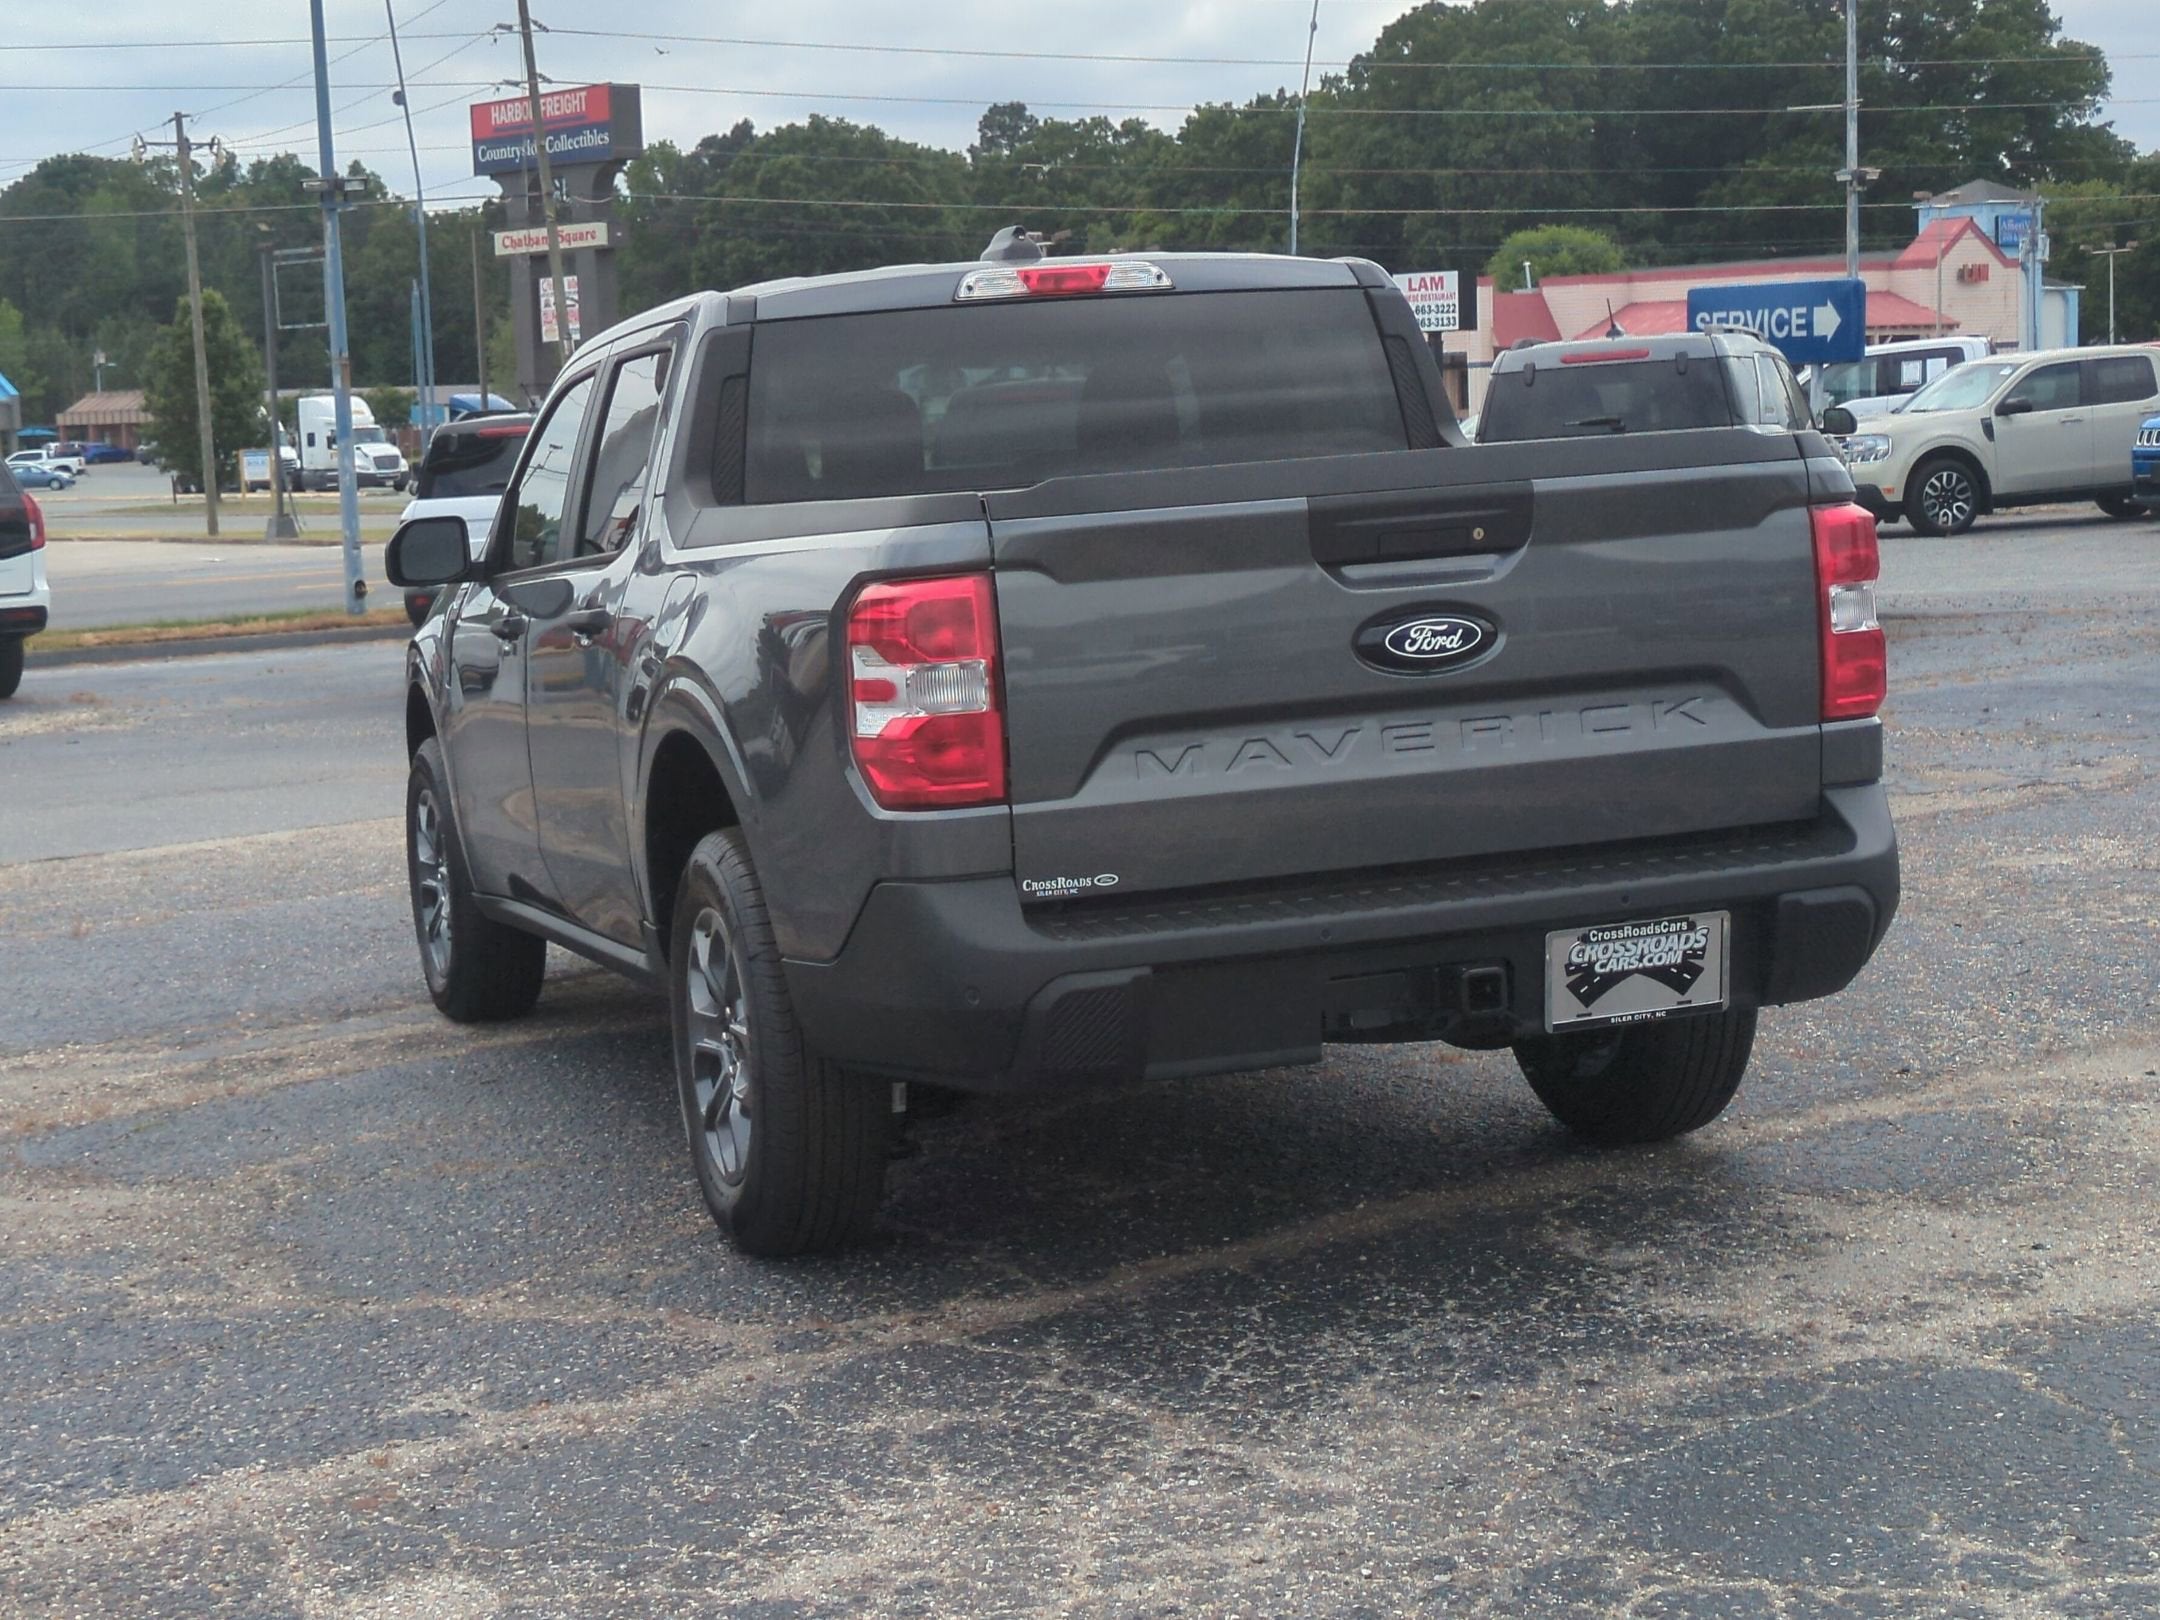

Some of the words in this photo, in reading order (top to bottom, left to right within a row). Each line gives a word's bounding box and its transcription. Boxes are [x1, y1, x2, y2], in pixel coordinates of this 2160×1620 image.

[540, 91, 587, 118] FREIGHT
[478, 139, 538, 163] Countrysid
[545, 128, 610, 153] Collectibles
[557, 229, 597, 246] Square
[1408, 275, 1445, 292] LAM
[1420, 316, 1457, 328] 63-3133
[1404, 624, 1464, 652] Ford
[1135, 697, 1707, 780] MAVERICK
[1589, 920, 1688, 942] CrossRoadsCars
[1569, 926, 1710, 963] CROSSROADS
[1594, 950, 1684, 973] CARS.COM
[1610, 1015, 1632, 1024] SILER
[1655, 1010, 1667, 1018] NC
